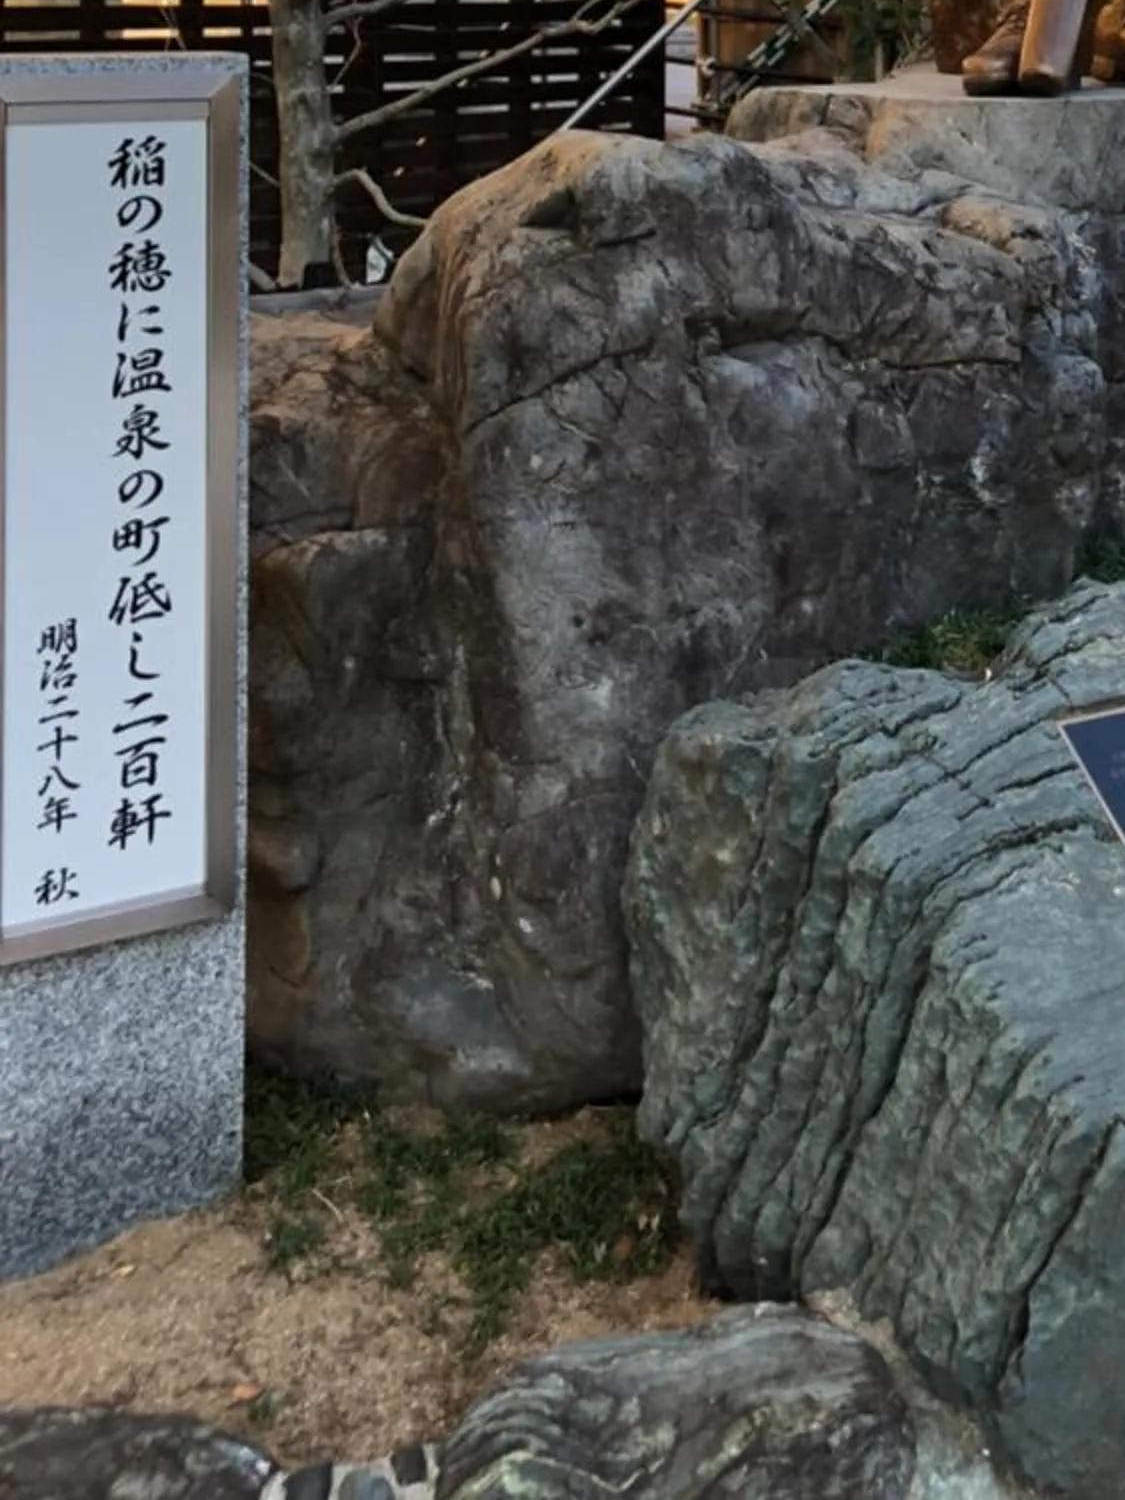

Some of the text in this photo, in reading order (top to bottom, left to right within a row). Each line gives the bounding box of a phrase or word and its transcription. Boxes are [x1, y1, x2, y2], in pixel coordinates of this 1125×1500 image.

[107, 135, 172, 850] 稲の穂に温泉の町低し二百軒
[34, 617, 80, 905] 明治二十八年 秋
